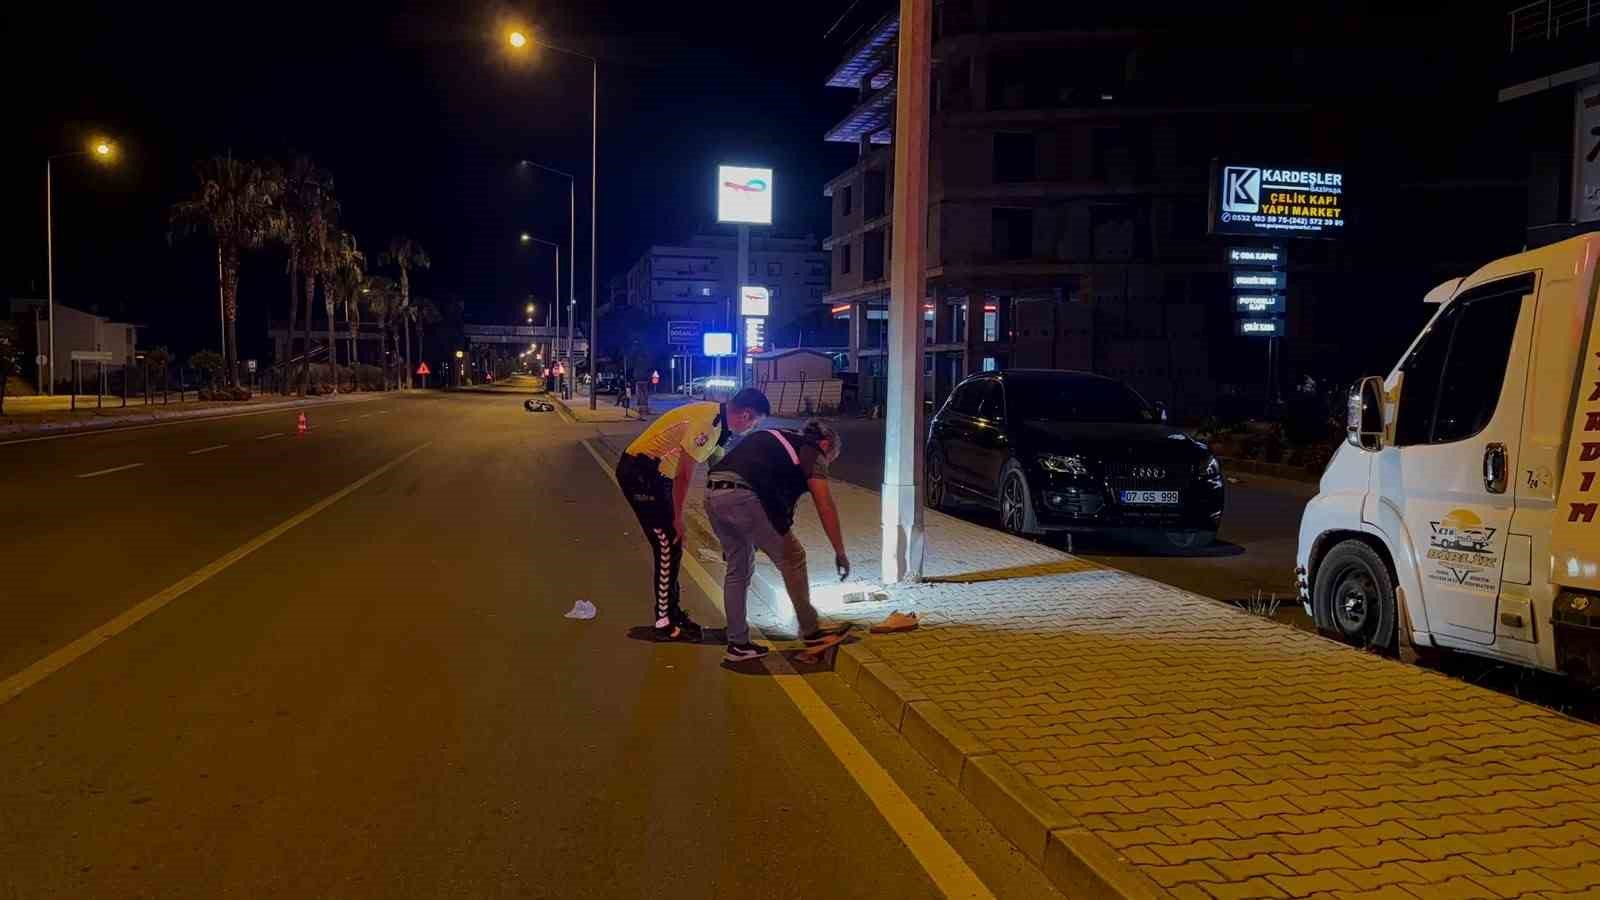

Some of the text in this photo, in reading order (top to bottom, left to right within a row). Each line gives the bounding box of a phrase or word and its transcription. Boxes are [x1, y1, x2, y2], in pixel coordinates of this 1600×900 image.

[1262, 169, 1342, 187] KARDEŞLER
[1270, 192, 1337, 206] ÇELİK KAPI
[1262, 204, 1342, 218] YAPI MARKET
[1126, 492, 1137, 501] 07
